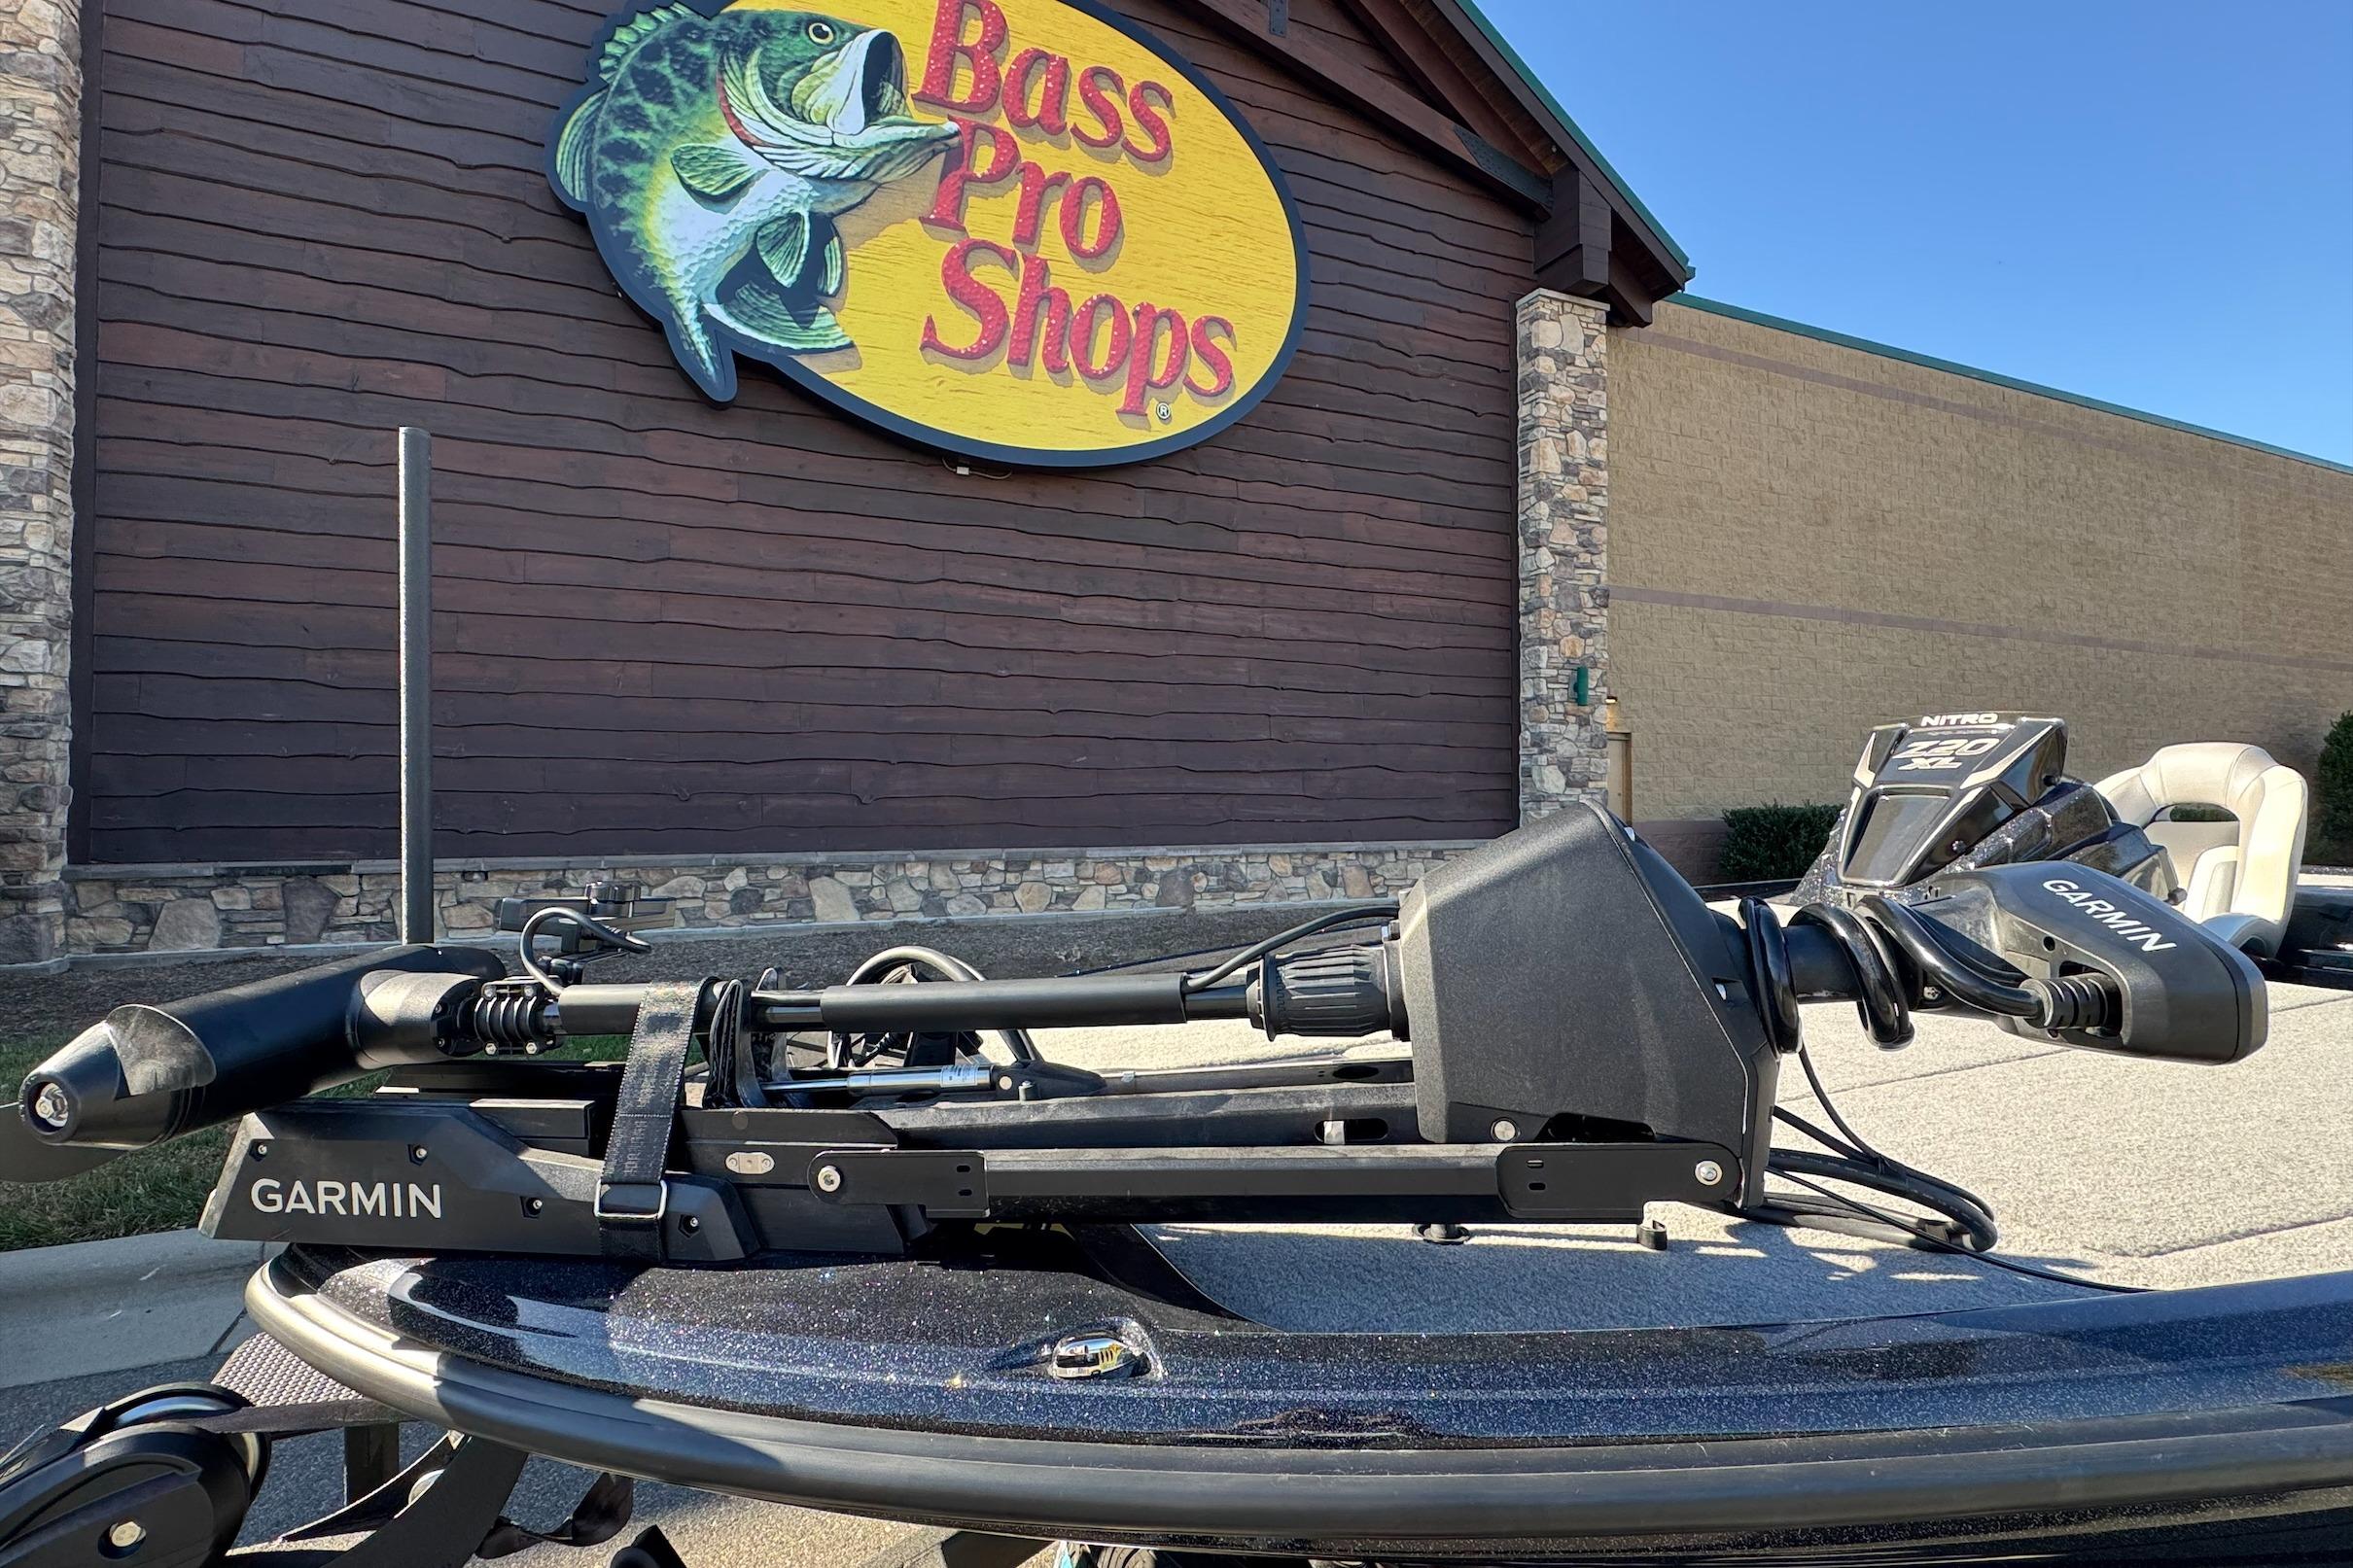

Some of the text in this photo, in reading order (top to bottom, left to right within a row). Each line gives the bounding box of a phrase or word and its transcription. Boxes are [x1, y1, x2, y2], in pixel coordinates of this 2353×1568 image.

[911, 0, 1173, 163] Bass
[919, 115, 1122, 260] Pro
[919, 237, 1234, 418] Shops
[1892, 738, 2000, 759] Z20
[1920, 713, 1998, 727] NITRO
[1898, 756, 1963, 771] XL
[2042, 879, 2178, 952] GARMIN
[250, 1177, 442, 1219] GARMIN
